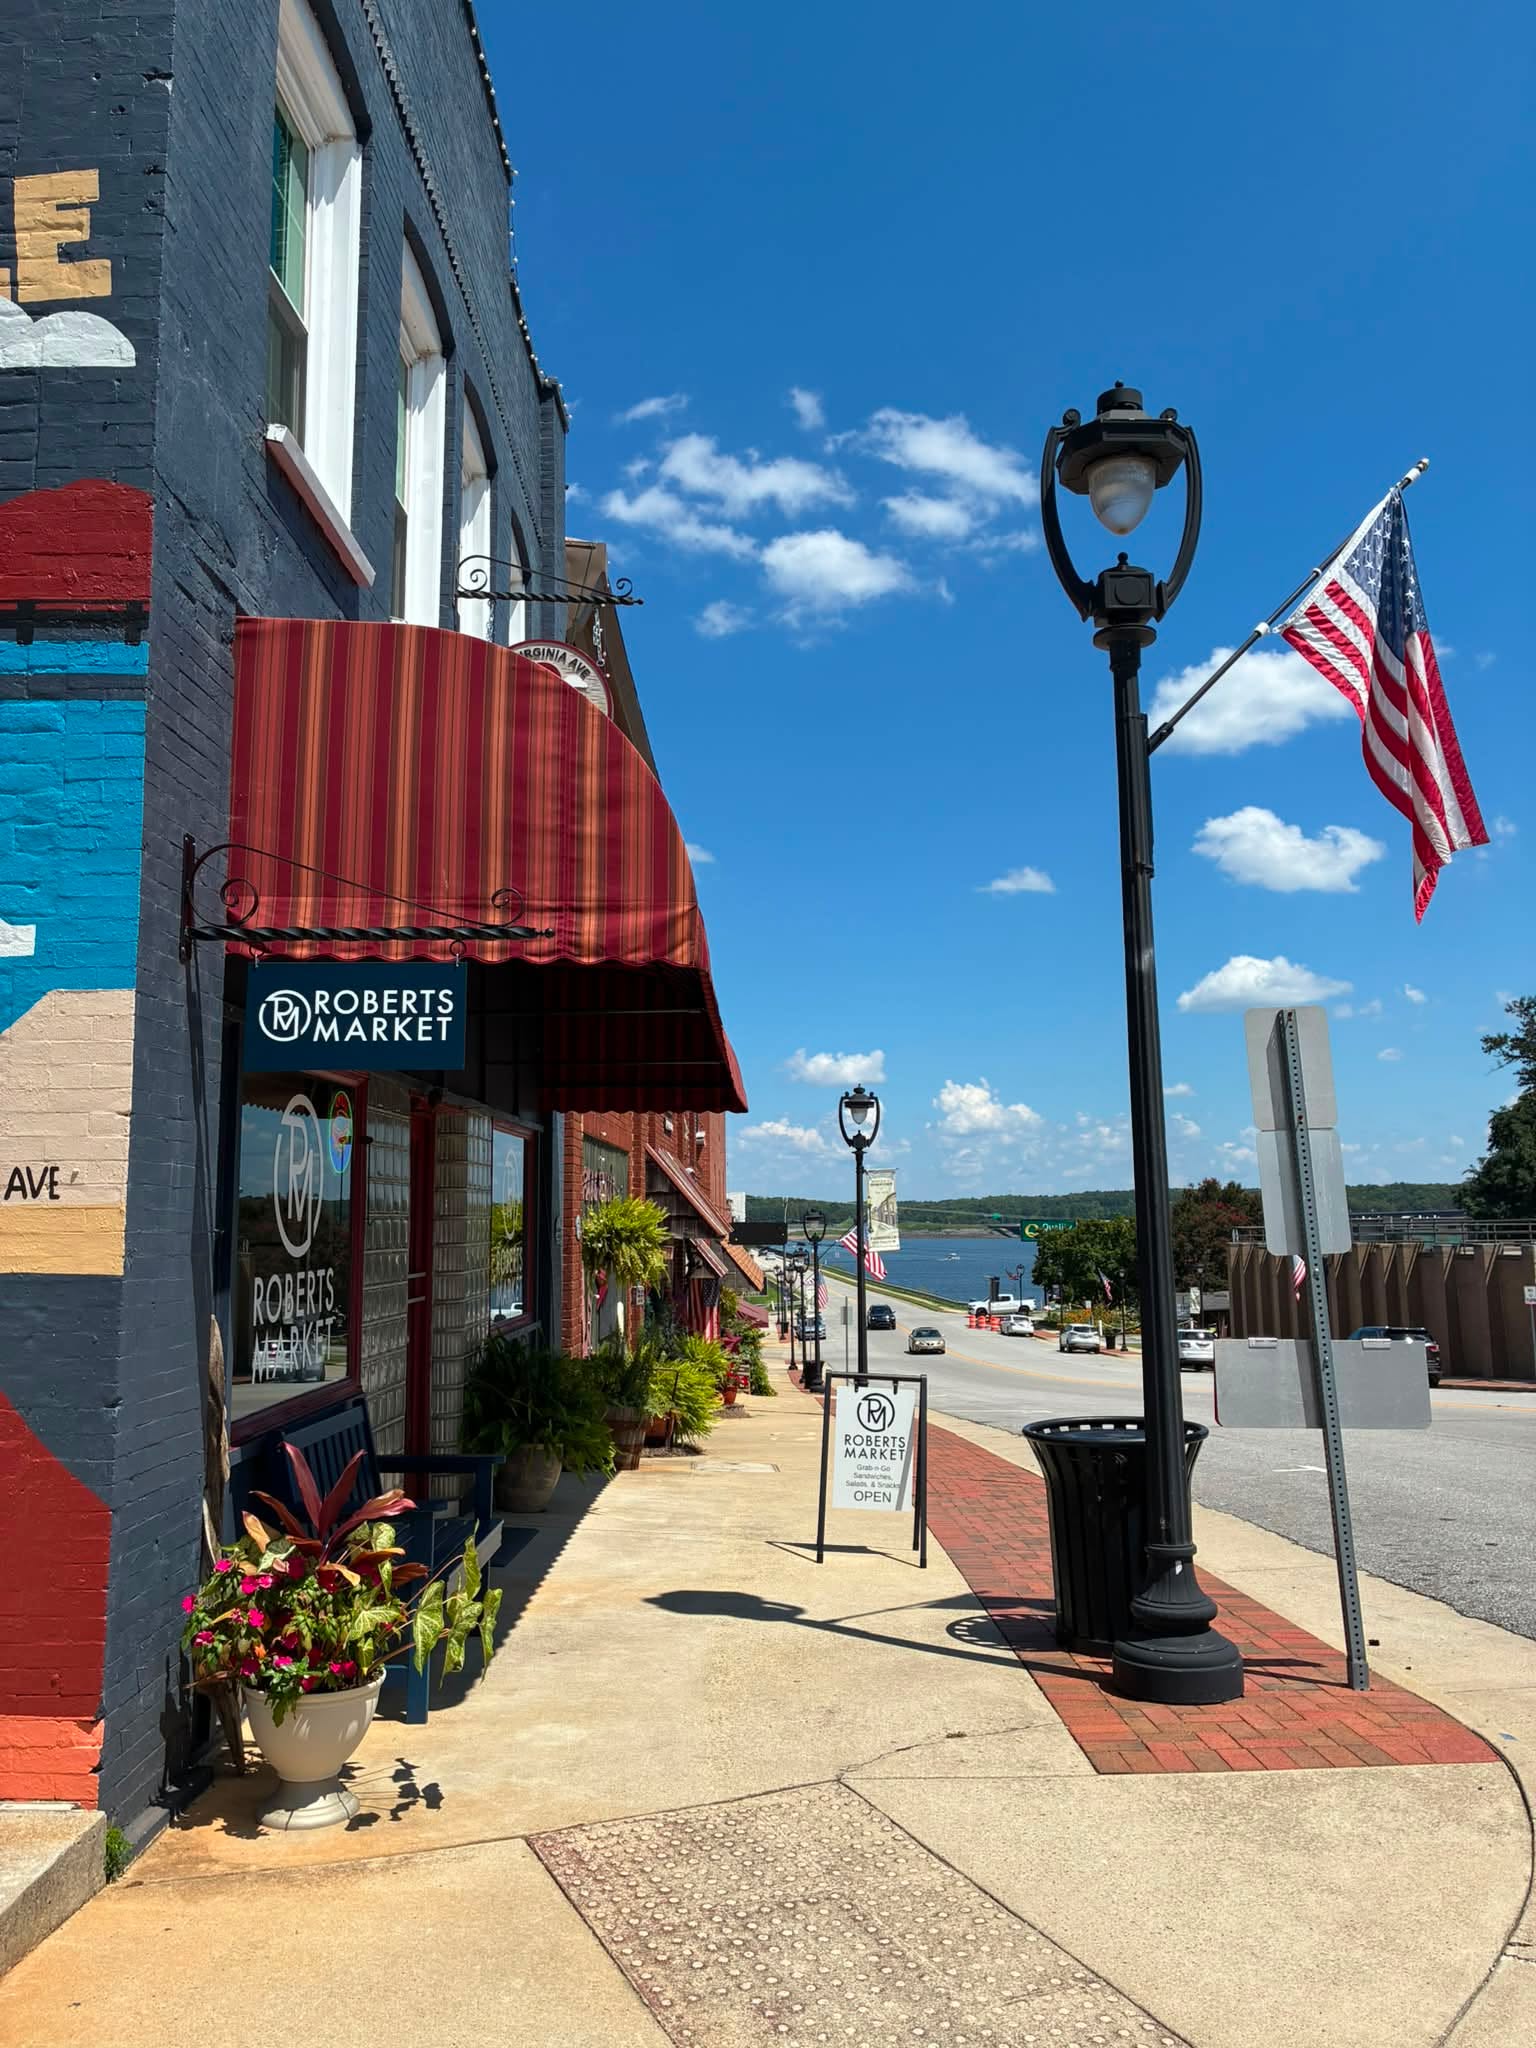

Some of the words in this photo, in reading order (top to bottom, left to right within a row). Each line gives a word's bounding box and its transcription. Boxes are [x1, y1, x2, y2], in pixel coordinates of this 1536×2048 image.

[0, 168, 112, 303] E
[520, 648, 567, 664] RGINIA
[568, 658, 590, 680] AVE
[314, 990, 454, 1015] ROBERTS
[313, 1015, 453, 1042] MARKET
[4, 1166, 61, 1201] AVE
[252, 1266, 335, 1328] ROBERTS
[251, 1315, 335, 1385] MARKET
[844, 1434, 906, 1448] ROBERTS
[844, 1448, 906, 1461] MARKET
[853, 1490, 892, 1503] OPEN
